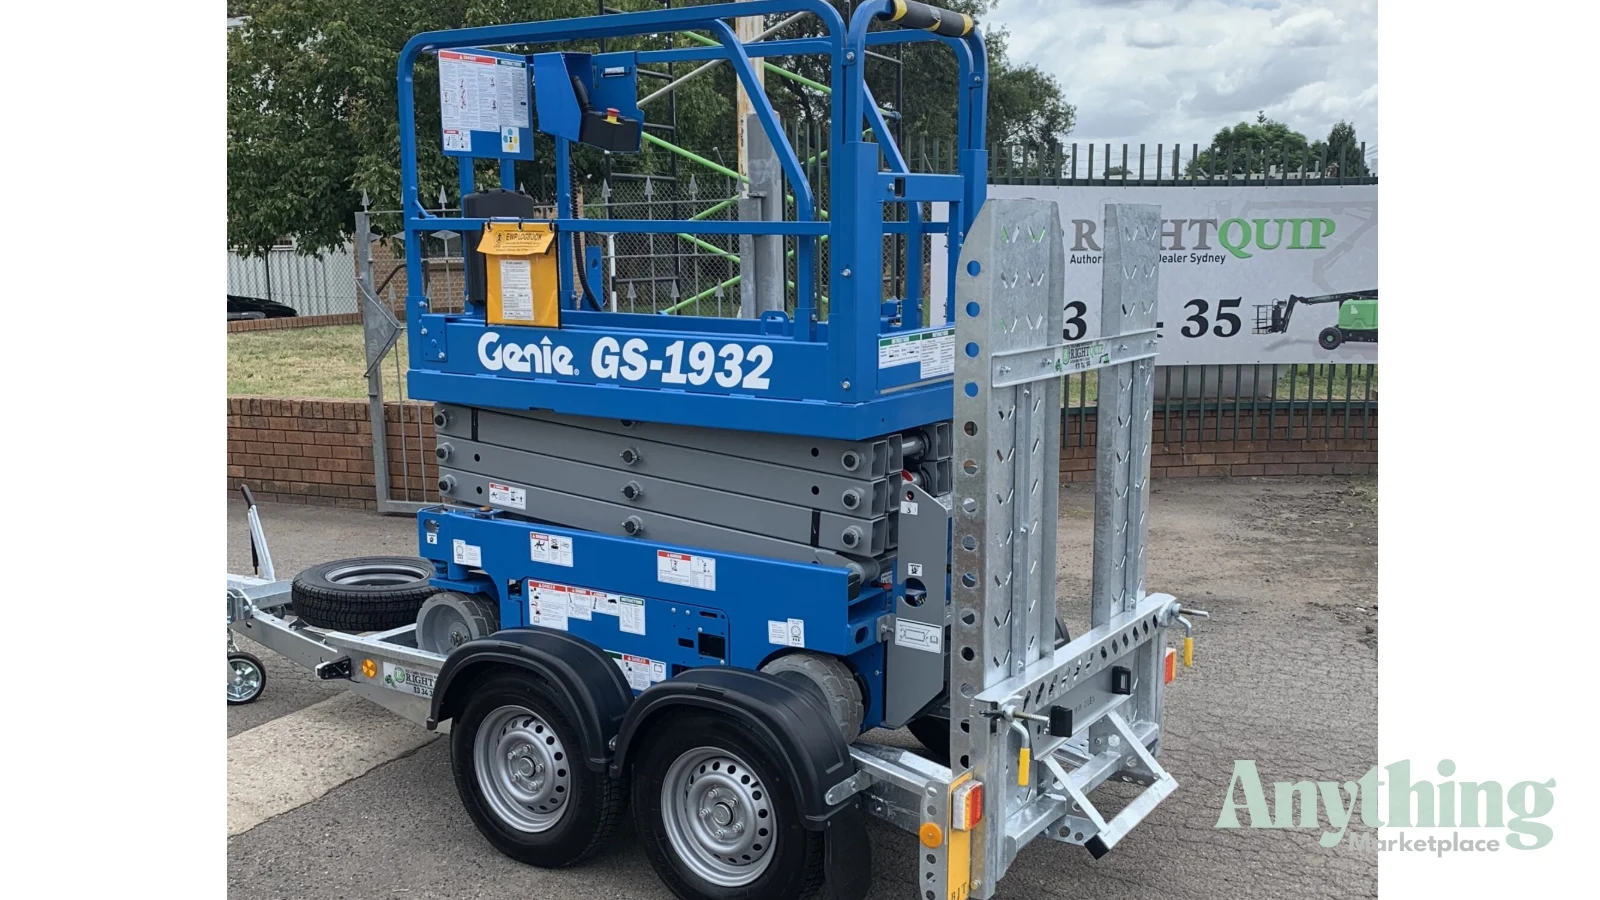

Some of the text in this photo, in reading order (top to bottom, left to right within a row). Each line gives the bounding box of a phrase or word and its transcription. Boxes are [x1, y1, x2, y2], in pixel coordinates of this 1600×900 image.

[1070, 218, 1336, 259] RHTQUIP
[1070, 253, 1102, 264] Author
[1190, 252, 1226, 265] Sydney
[1181, 297, 1242, 338] 35
[591, 336, 773, 390] GS-1932
